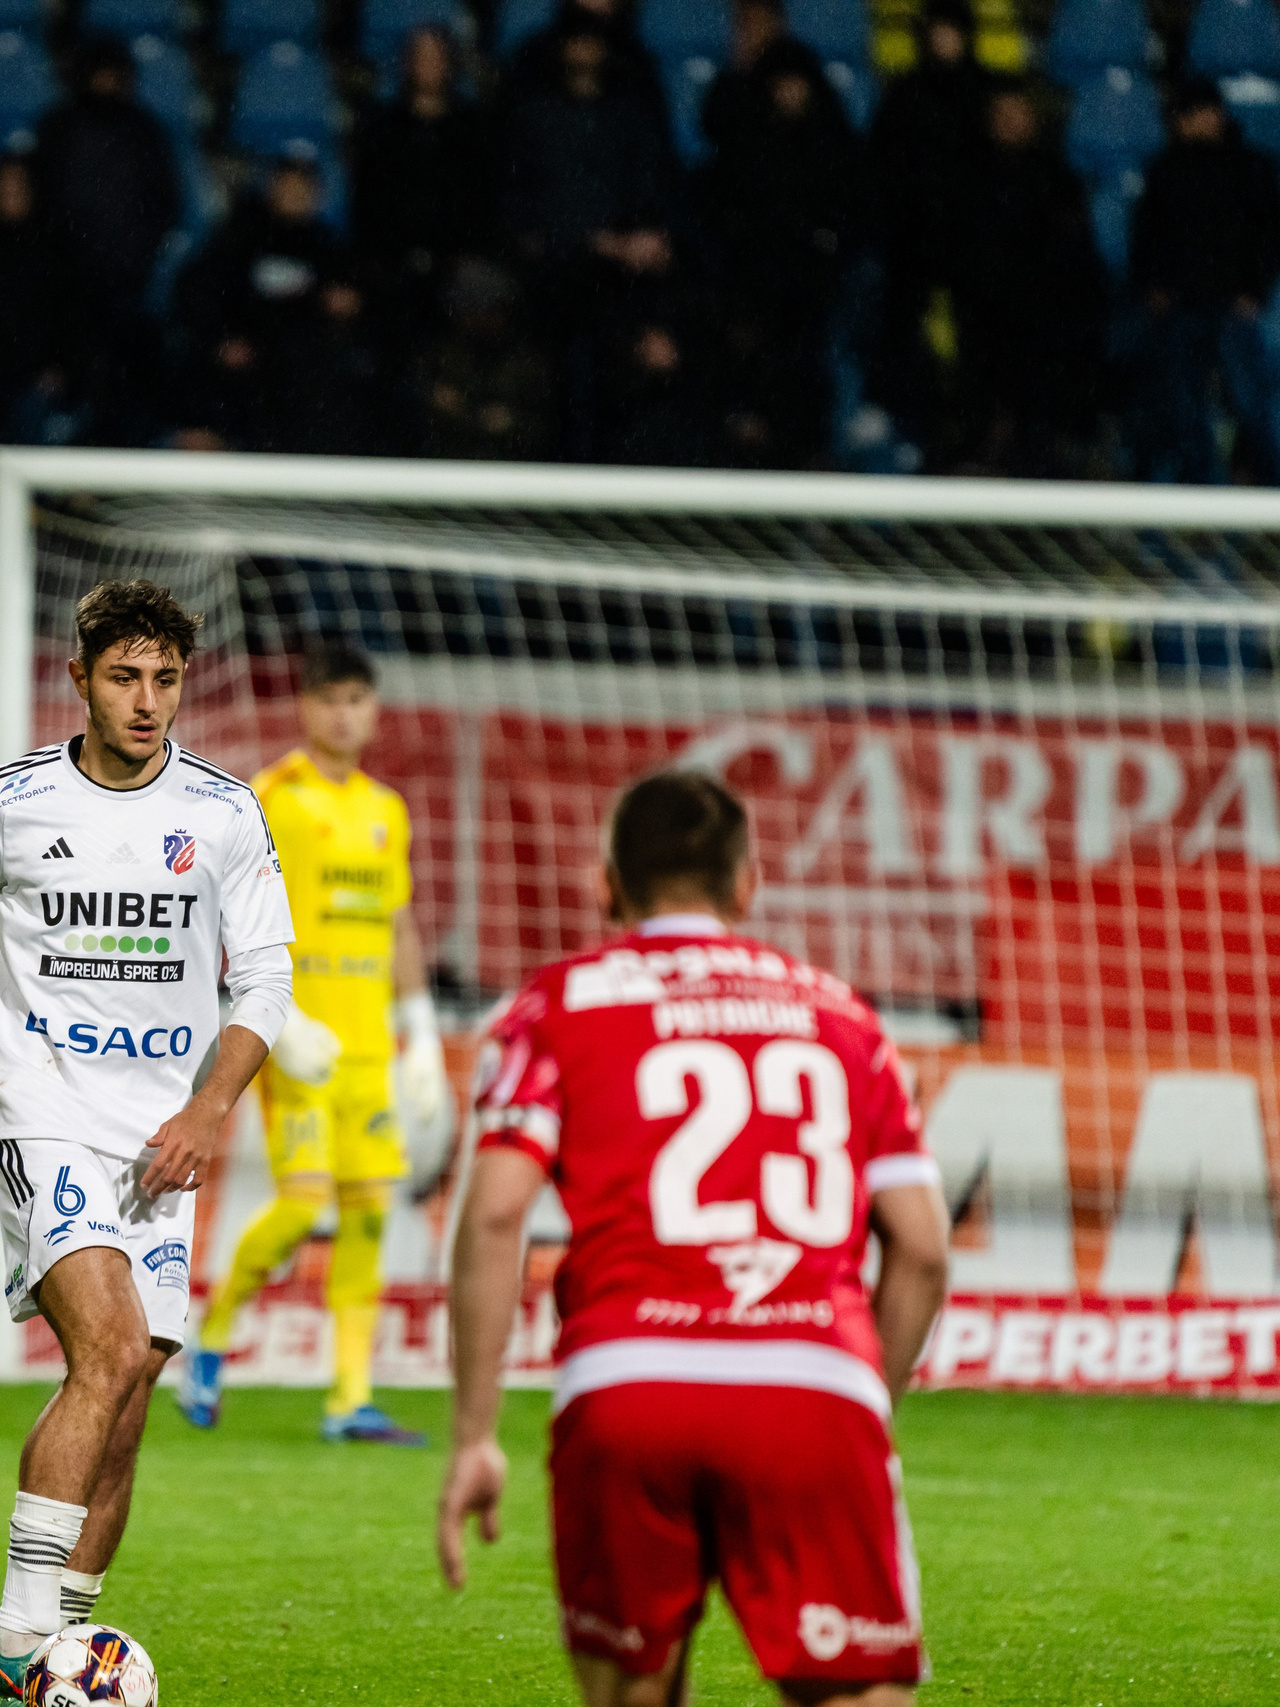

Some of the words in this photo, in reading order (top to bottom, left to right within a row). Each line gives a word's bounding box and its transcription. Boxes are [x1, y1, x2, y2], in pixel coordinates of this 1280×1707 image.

[40, 892, 198, 928] UNIBET
[49, 956, 120, 979] ÎMPREUNĂ
[123, 963, 159, 980] SPRE
[161, 965, 179, 980] 0%
[26, 1011, 193, 1059] SACO
[634, 1037, 855, 1248] 23
[53, 1165, 87, 1217] 6
[146, 1249, 167, 1268] FIVE
[923, 1305, 1280, 1384] PERBET
